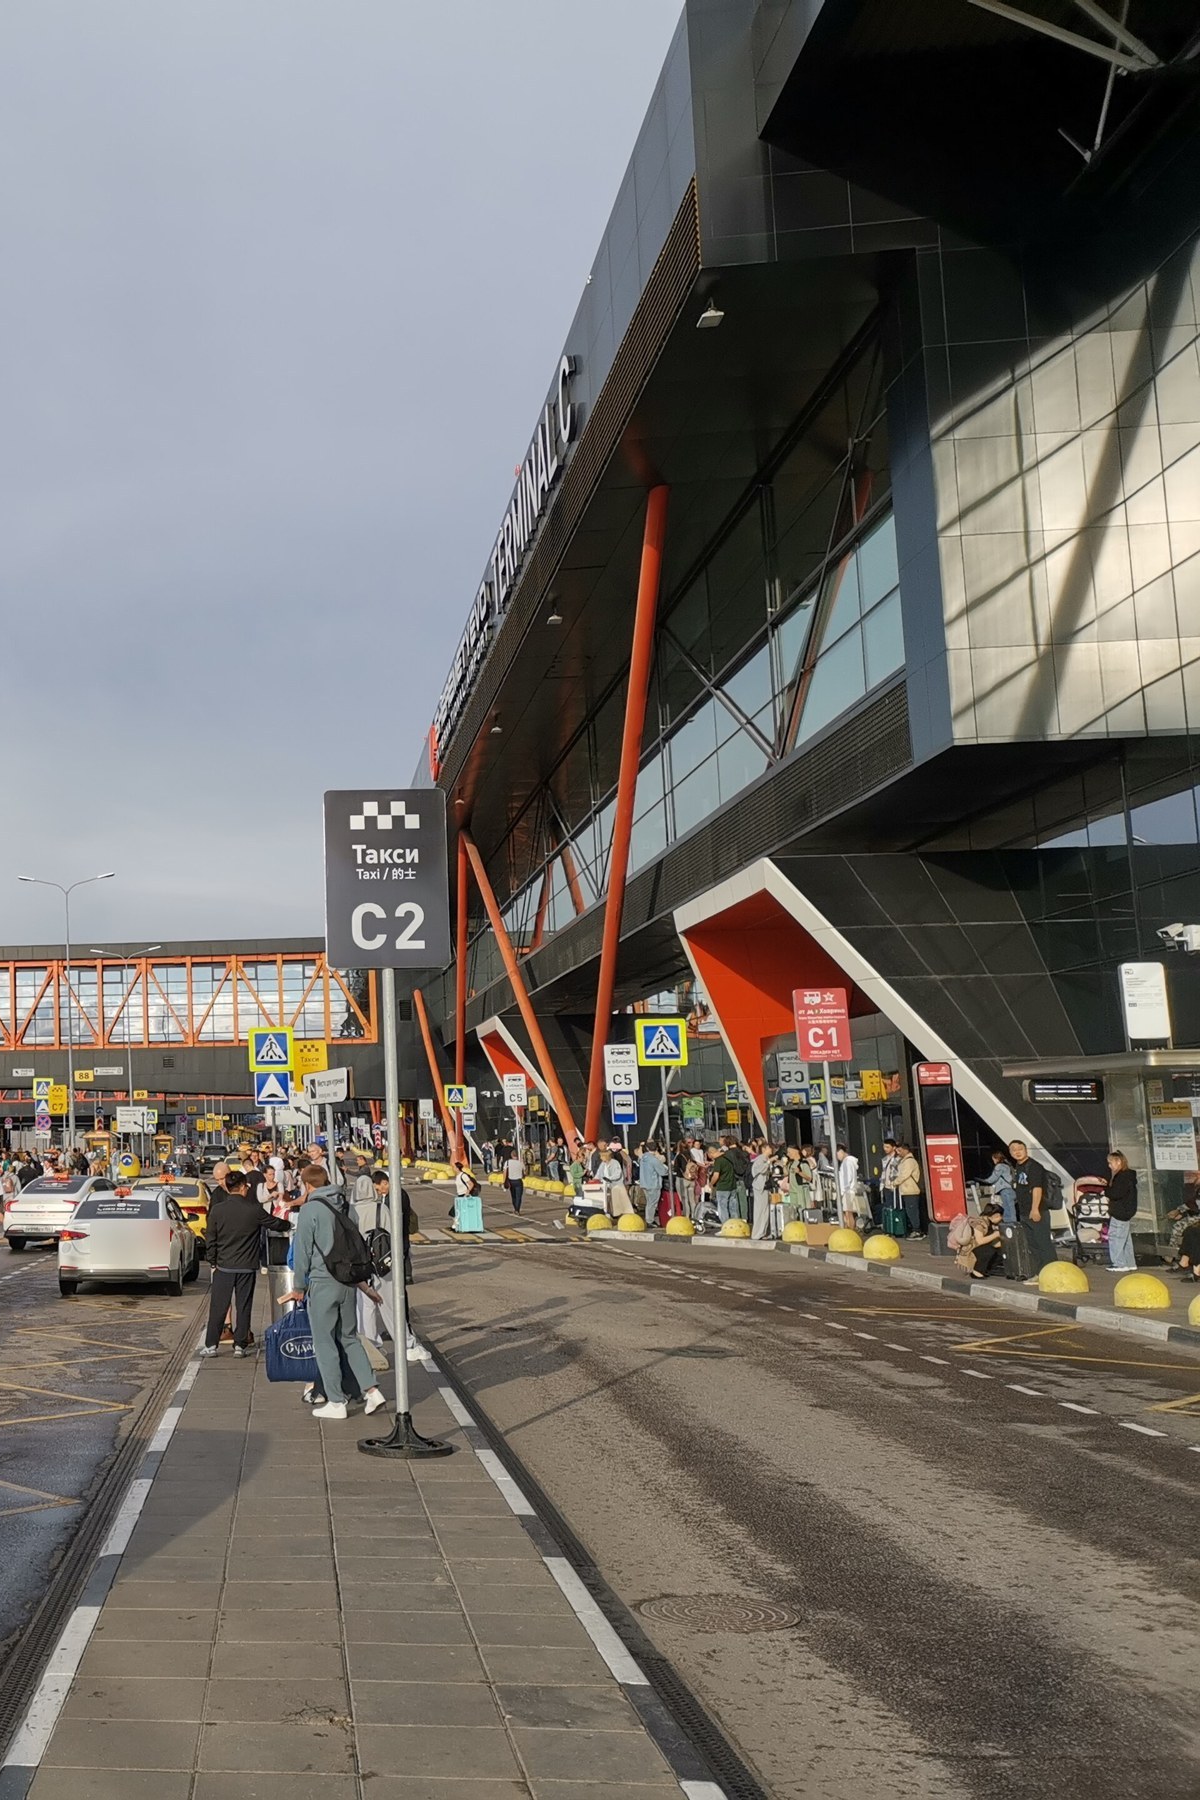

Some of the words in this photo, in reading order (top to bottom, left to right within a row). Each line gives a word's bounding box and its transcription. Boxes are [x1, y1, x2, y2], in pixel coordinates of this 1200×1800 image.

[491, 403, 560, 614] TERMINAL
[559, 355, 576, 443] C
[352, 844, 419, 864] Такси
[356, 869, 380, 880] Taxi
[383, 868, 389, 880] /
[392, 868, 416, 880] 的士
[351, 902, 426, 950] C2
[808, 1027, 837, 1048] C1
[613, 1074, 632, 1085] C5
[509, 1093, 522, 1102] C5
[52, 1103, 63, 1111] C7
